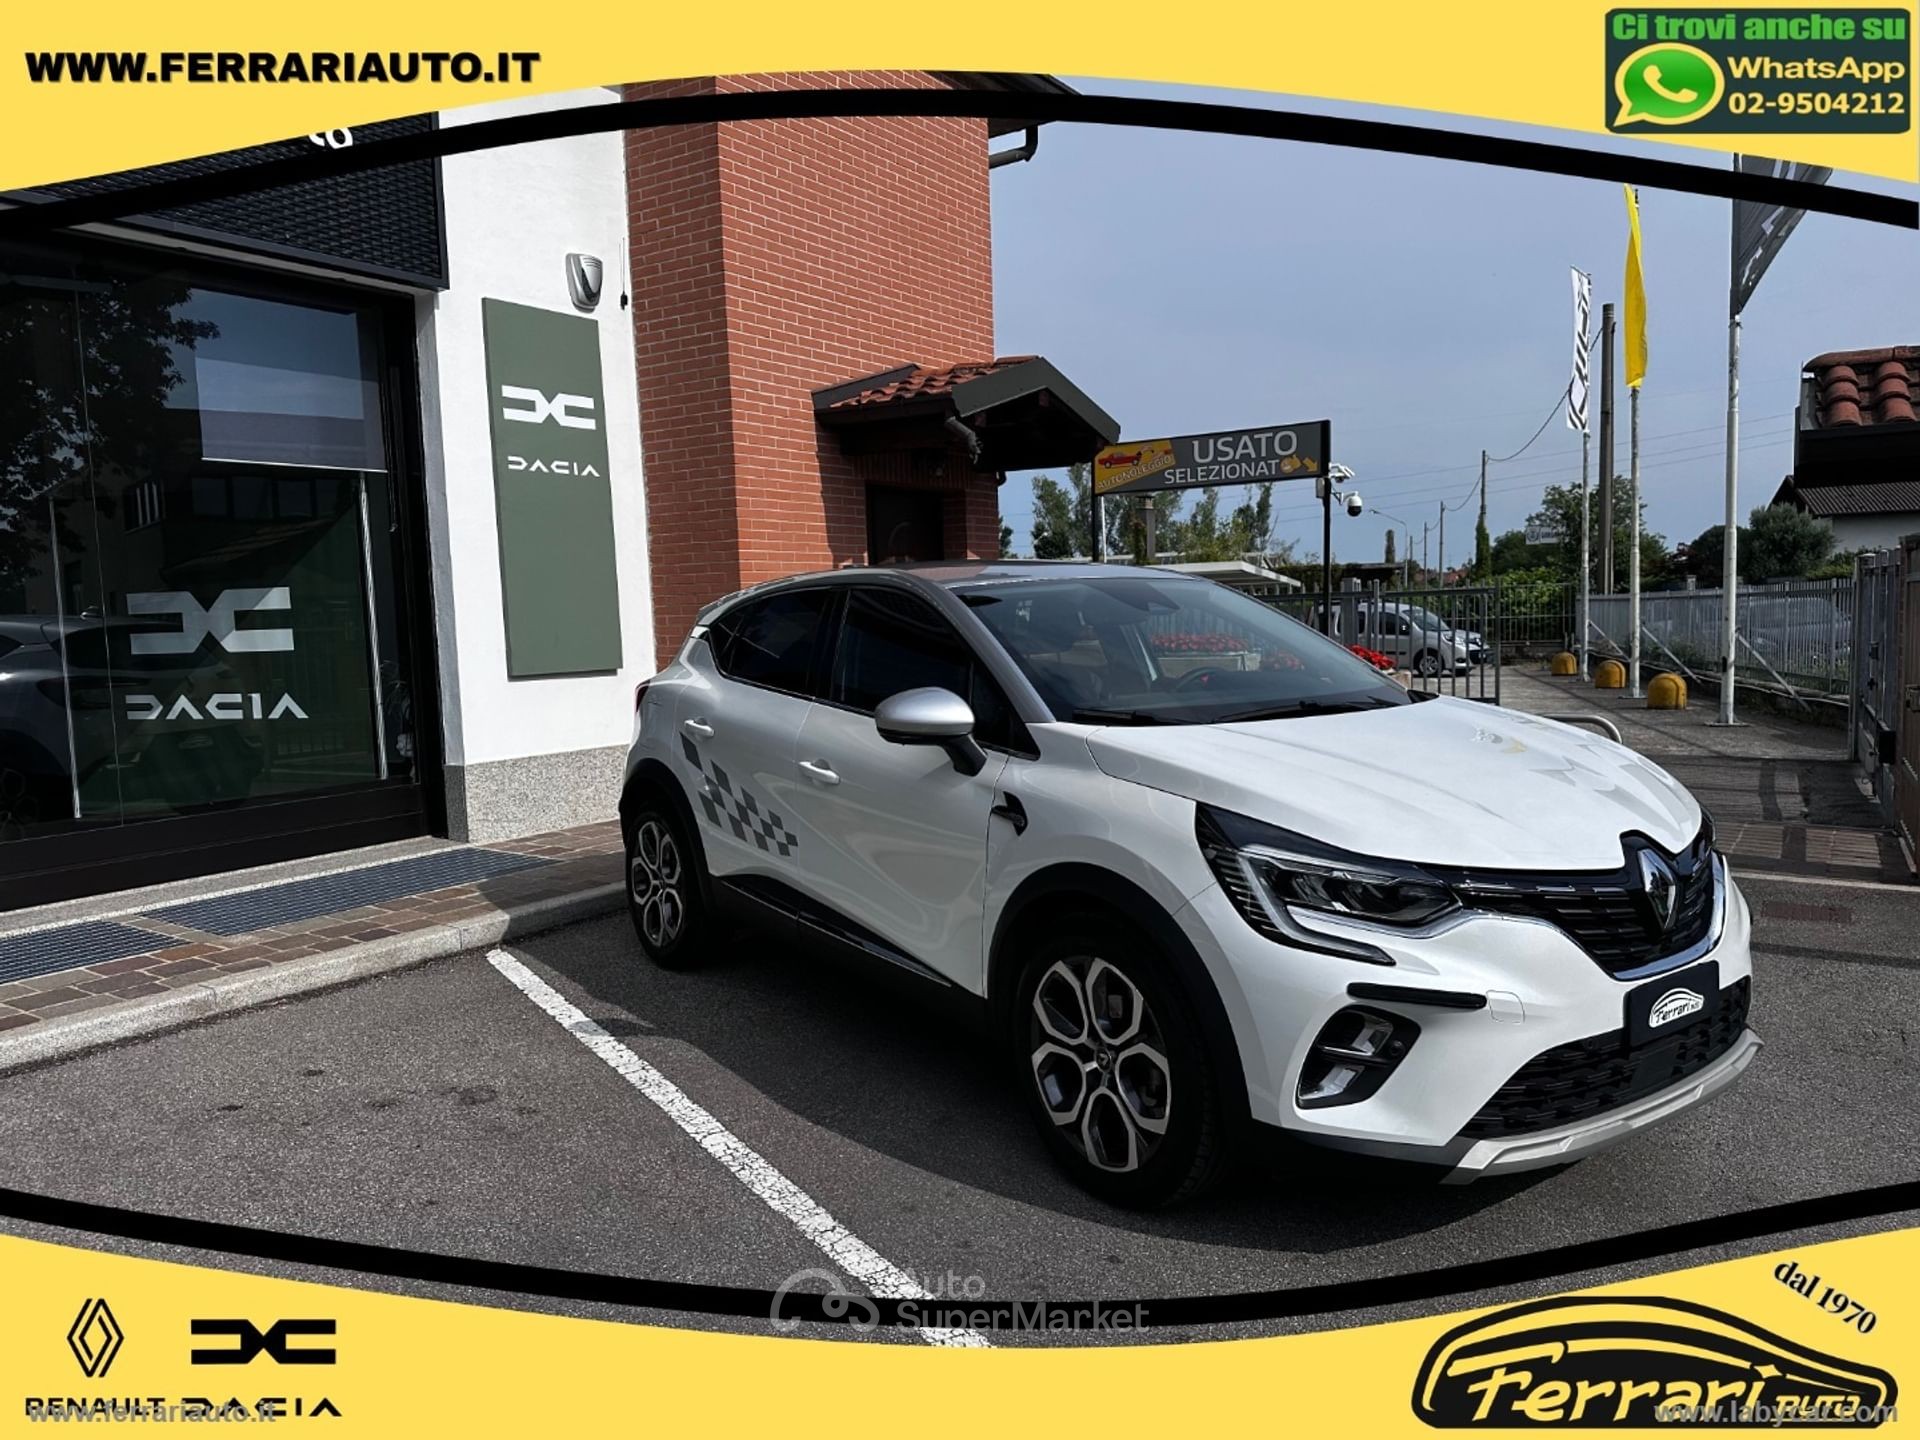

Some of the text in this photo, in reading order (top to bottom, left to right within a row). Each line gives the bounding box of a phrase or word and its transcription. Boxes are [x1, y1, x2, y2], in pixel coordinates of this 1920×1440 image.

[1192, 430, 1298, 464] USATO
[507, 455, 601, 478] DACIA
[125, 692, 309, 720] DACIA
